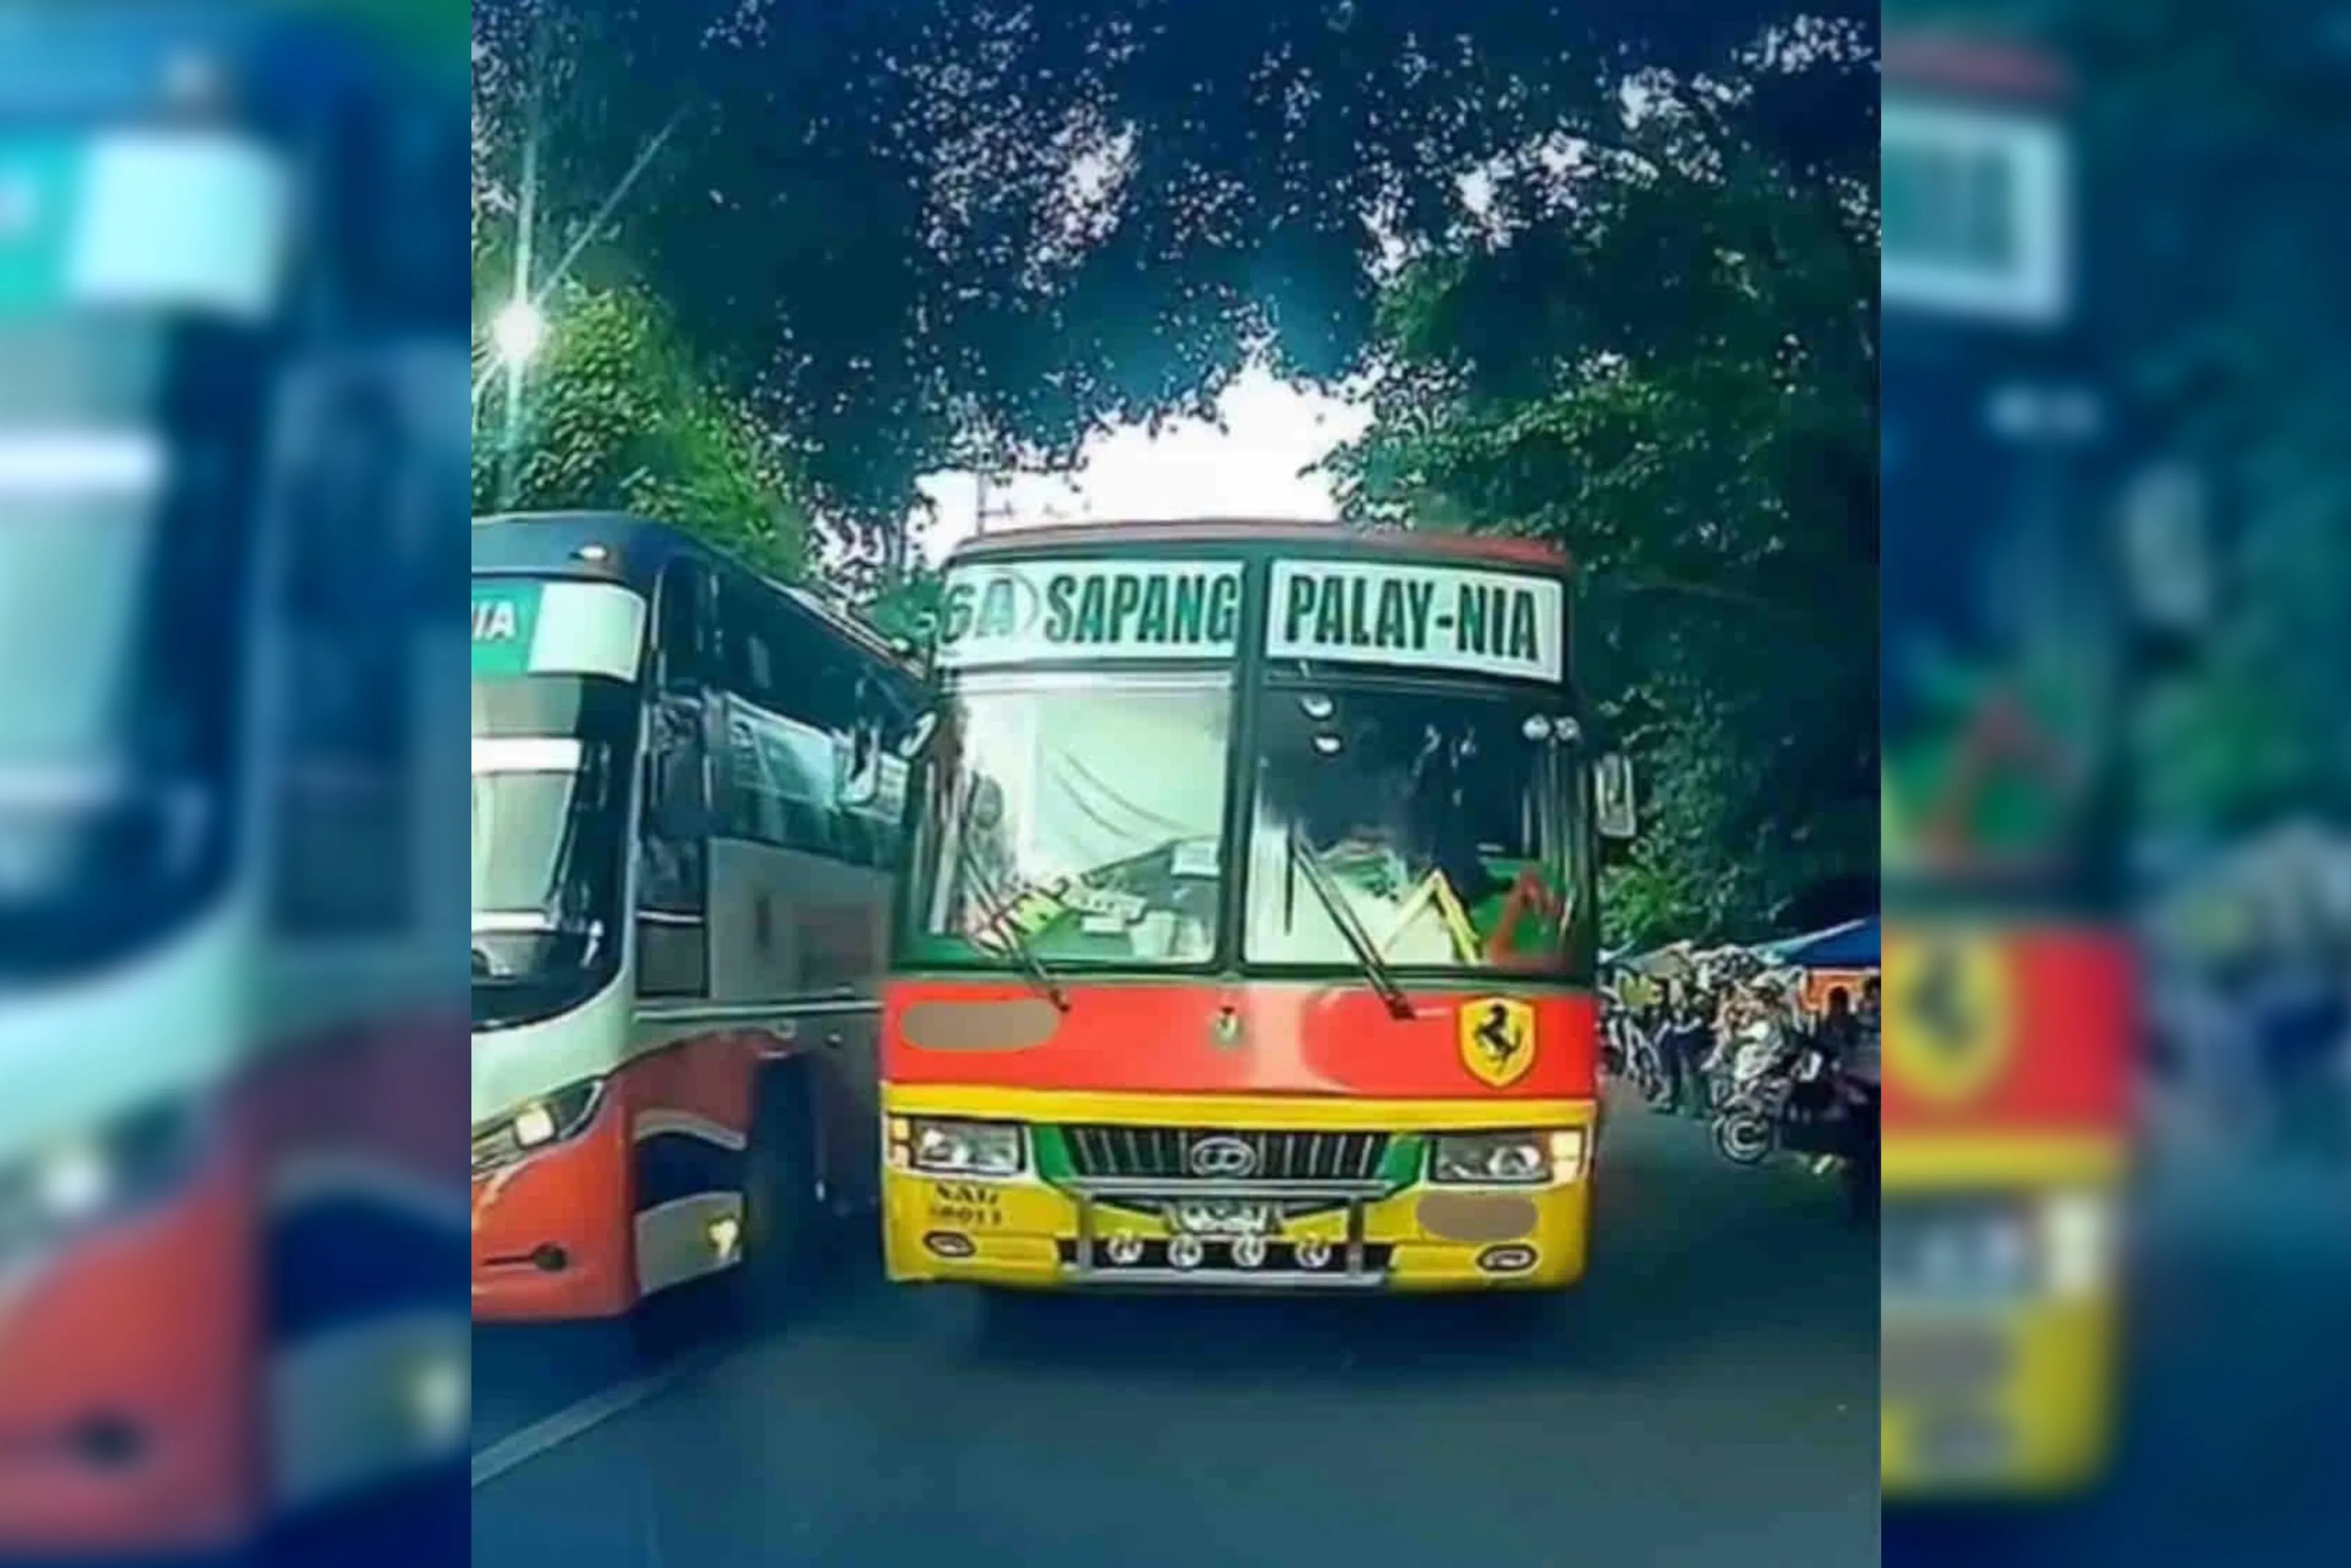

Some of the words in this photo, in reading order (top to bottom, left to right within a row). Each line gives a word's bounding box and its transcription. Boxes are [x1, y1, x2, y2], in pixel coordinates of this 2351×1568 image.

[471, 600, 516, 640] IA
[1044, 573, 1239, 644] SAPANG
[1284, 573, 1539, 662] PALAY-NIA
